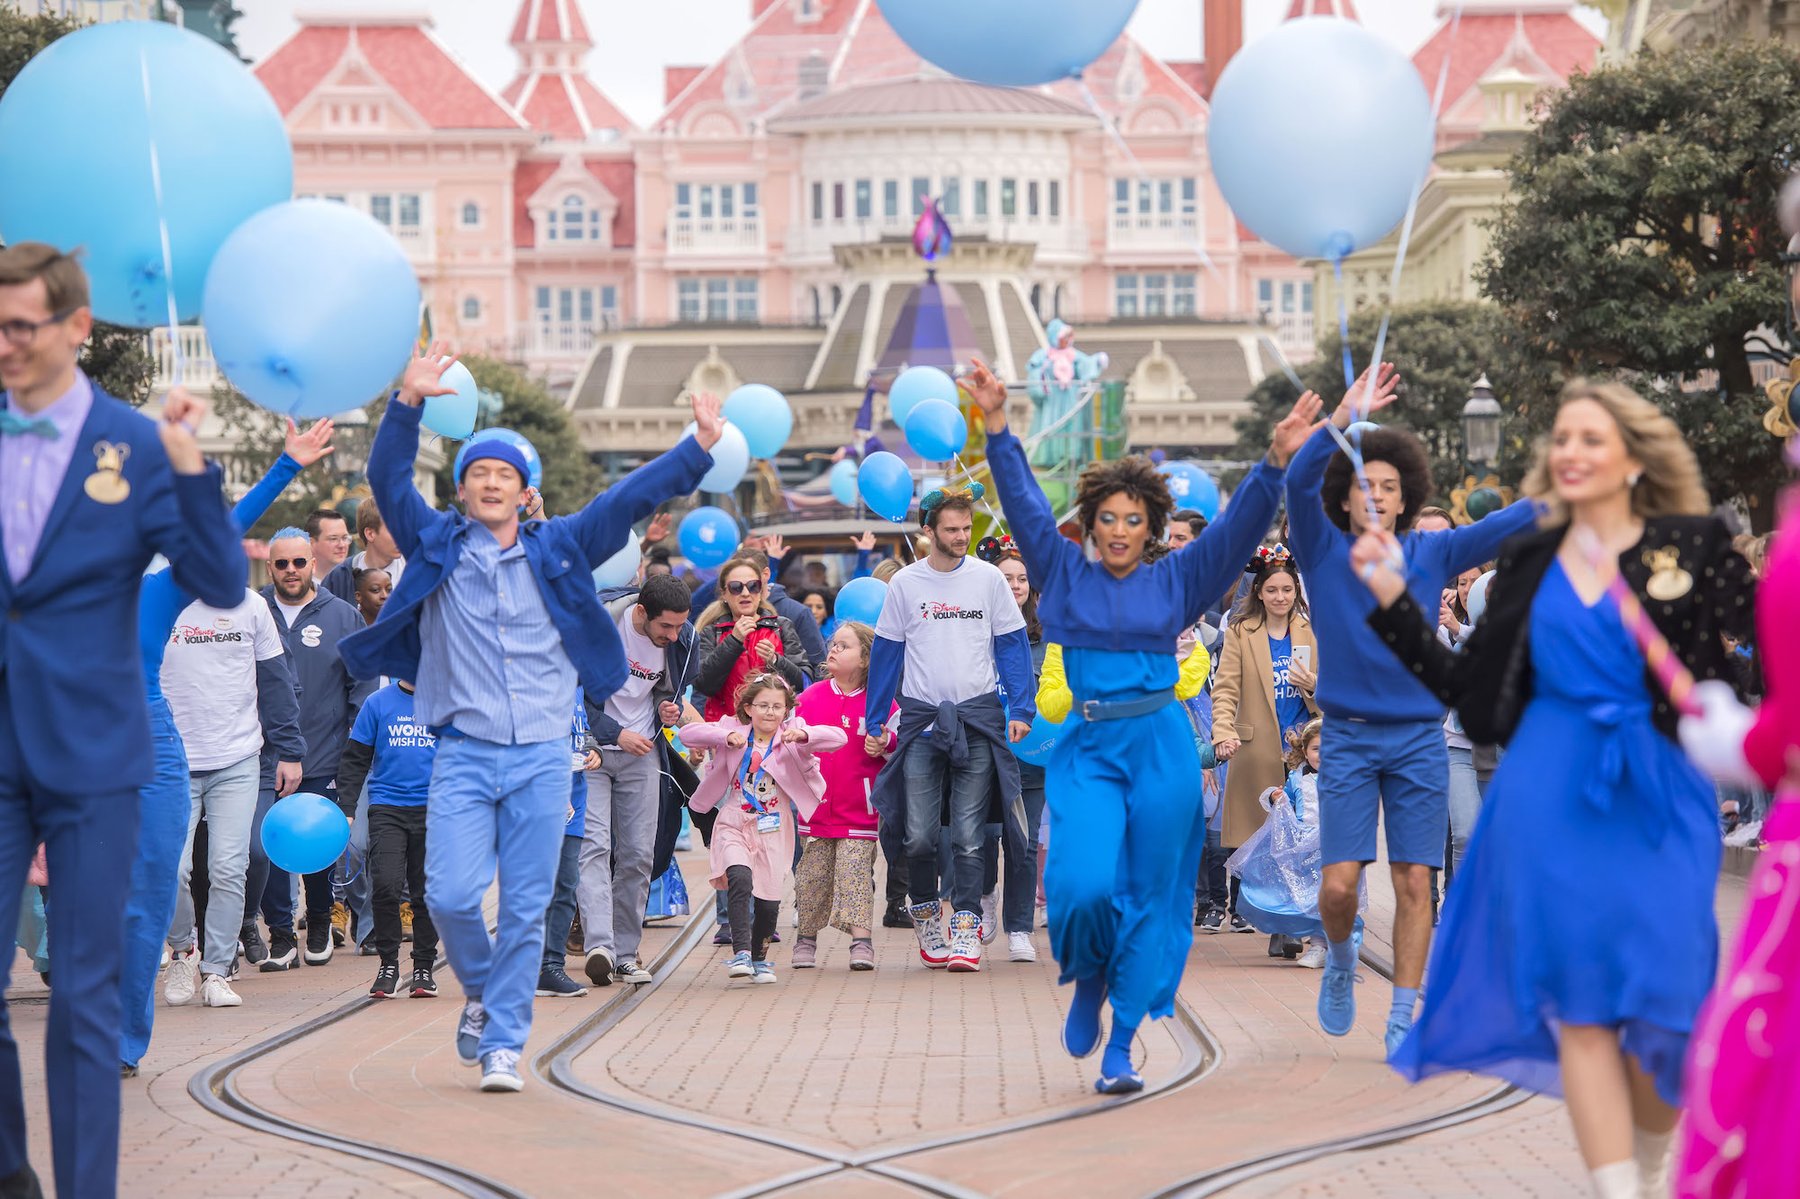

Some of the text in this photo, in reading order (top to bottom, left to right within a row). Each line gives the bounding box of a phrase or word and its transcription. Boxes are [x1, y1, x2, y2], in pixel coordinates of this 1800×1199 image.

[930, 602, 960, 613] Disney
[933, 610, 983, 620] VOLUNTEARS
[180, 626, 215, 638] Disney
[184, 632, 242, 644] VOLUNTEARS
[1286, 685, 1303, 699] DA
[388, 724, 436, 739] WORL
[389, 737, 415, 747] WISH
